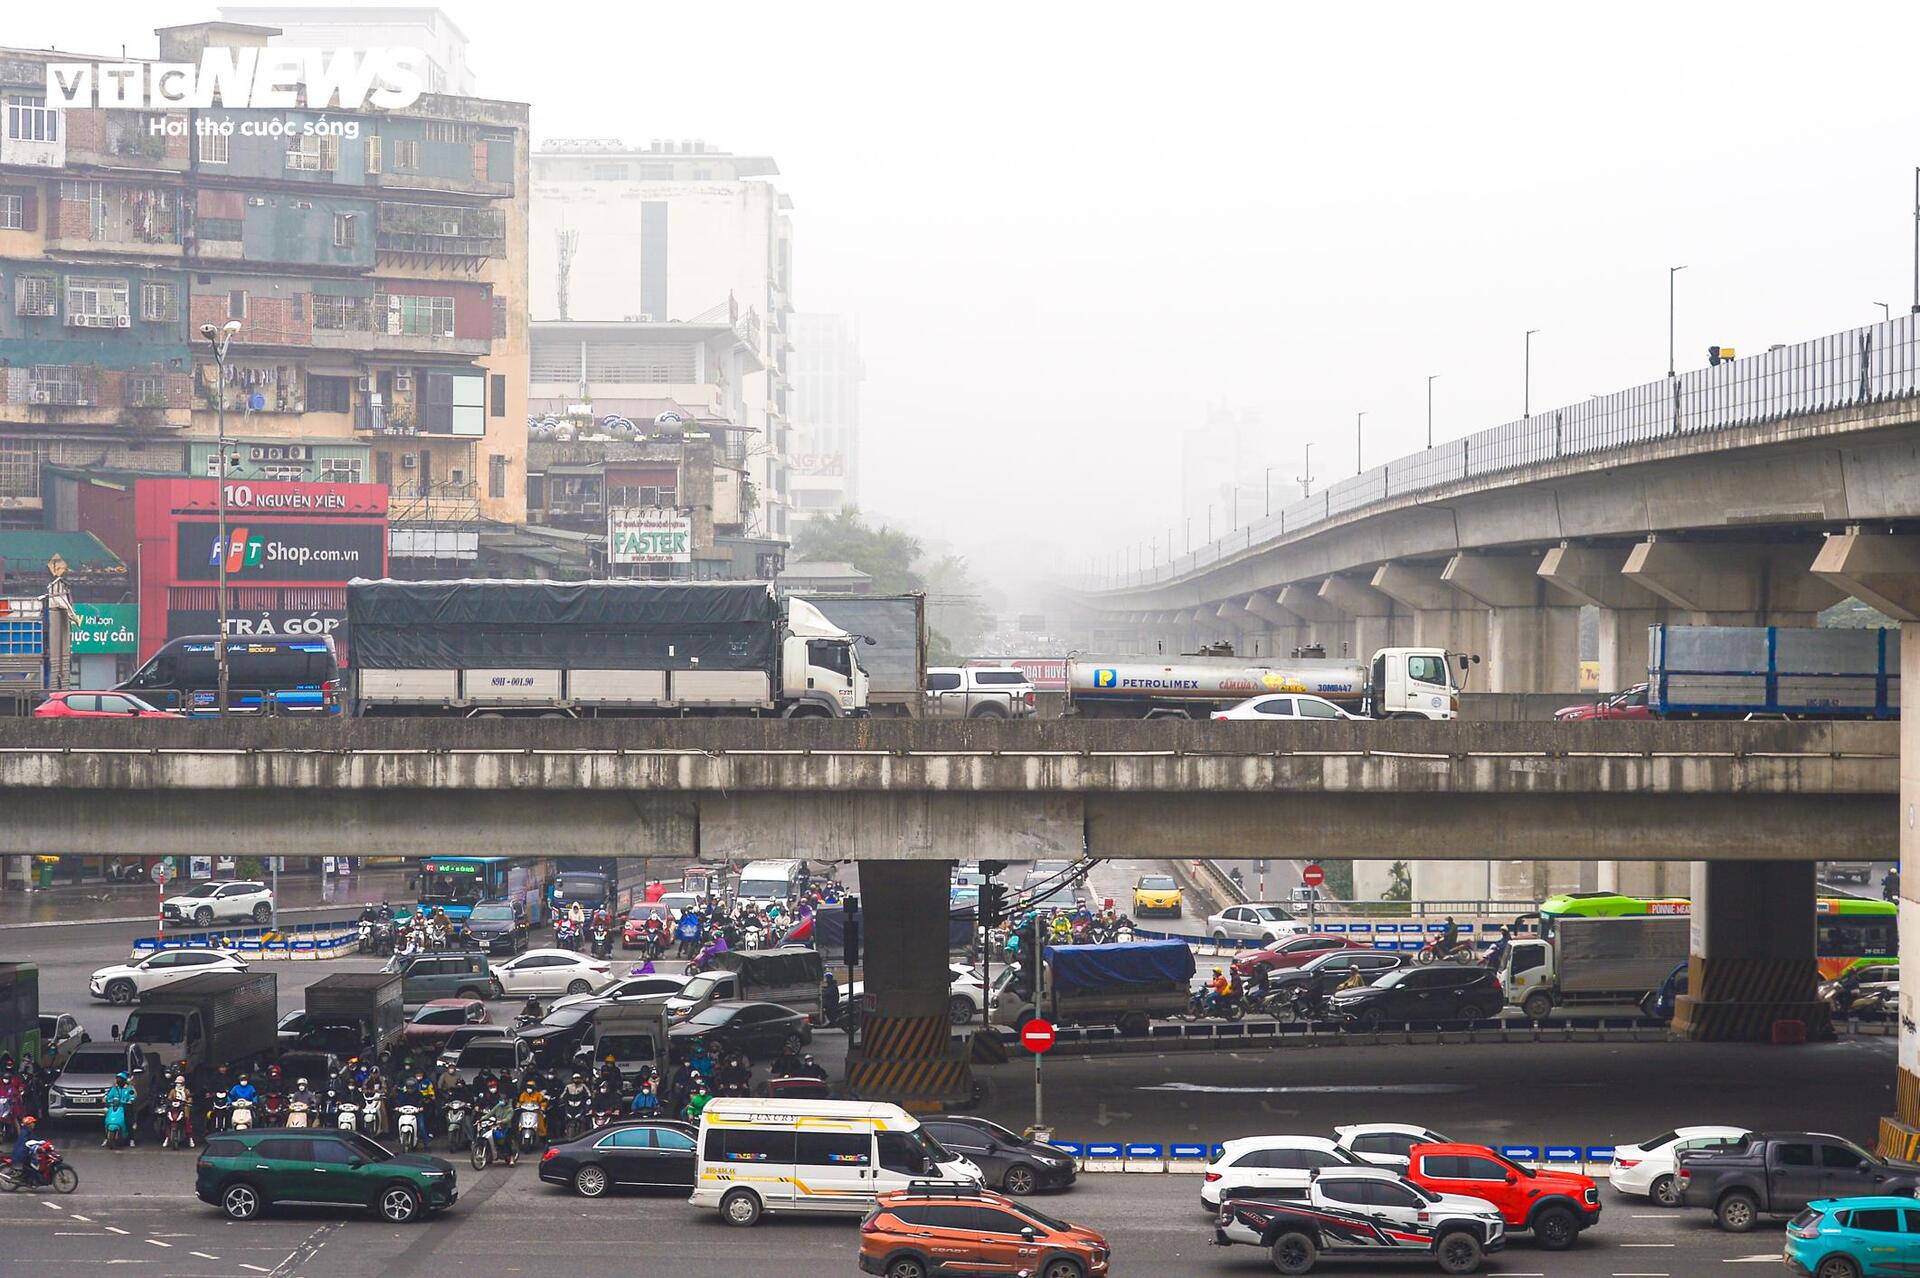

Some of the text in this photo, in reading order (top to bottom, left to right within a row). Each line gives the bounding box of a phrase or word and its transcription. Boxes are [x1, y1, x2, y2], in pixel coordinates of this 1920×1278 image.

[224, 485, 252, 507] 10
[256, 488, 311, 508] NGUYỄN
[267, 541, 359, 565] Shop.com.vn
[614, 532, 686, 554] FASTER
[218, 612, 339, 635] TRẢ GÓP
[93, 630, 107, 645] sự
[111, 625, 134, 642] cần
[1122, 679, 1198, 689] PETROLIMEX
